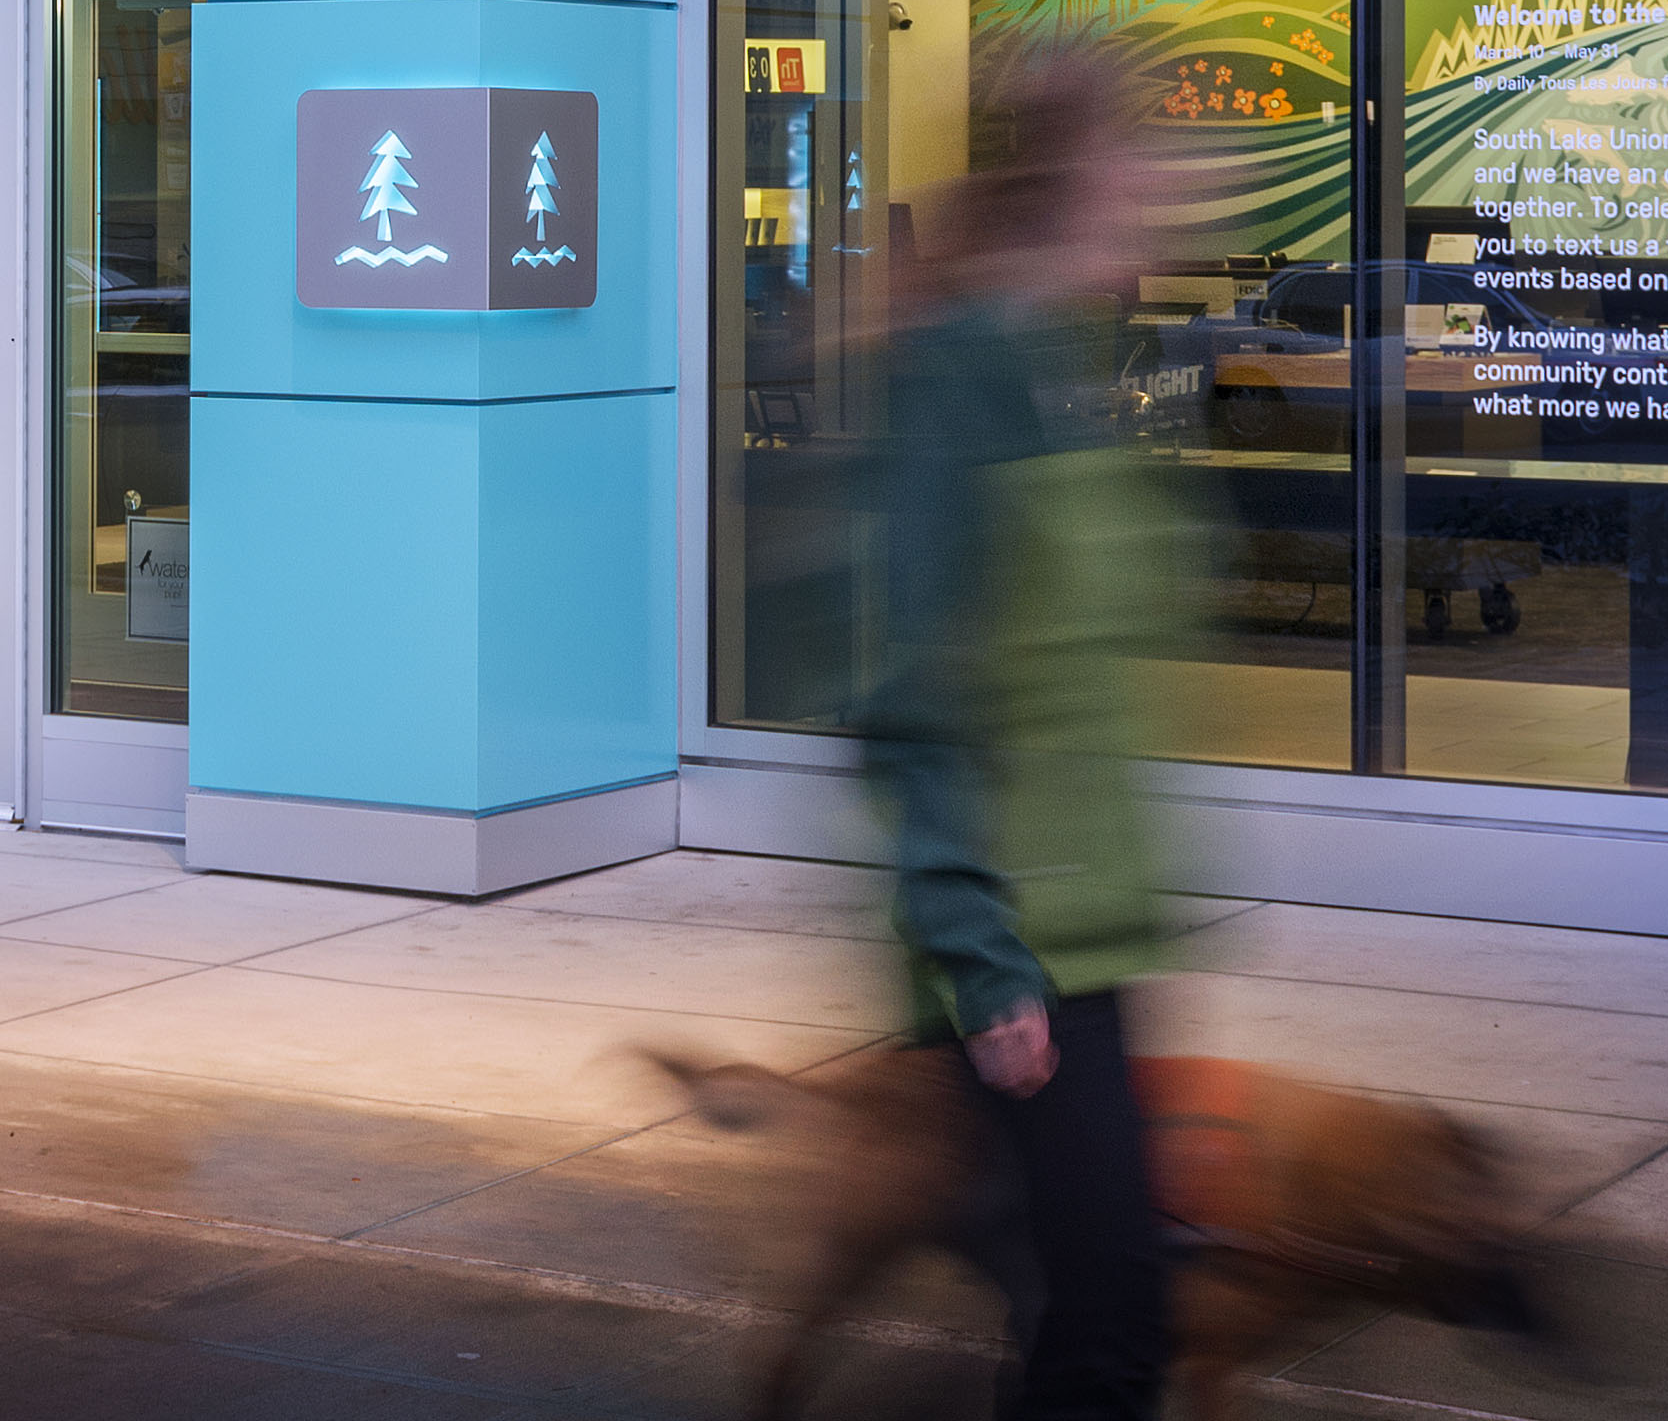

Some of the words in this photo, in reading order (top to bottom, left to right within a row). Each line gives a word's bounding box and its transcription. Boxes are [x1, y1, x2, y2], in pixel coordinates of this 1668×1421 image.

[1474, 5, 1582, 26] Welcome
[1590, 3, 1616, 25] to
[1623, 2, 1665, 24] the
[1474, 128, 1542, 150] South
[1550, 128, 1602, 150] Lake
[1474, 162, 1516, 184] and
[1523, 166, 1556, 184] we
[1564, 162, 1620, 184] have
[1627, 167, 1656, 184] an
[1474, 196, 1583, 221] together.
[1591, 196, 1618, 218] To
[1474, 236, 1515, 259] you
[1523, 234, 1546, 255] to
[1554, 234, 1603, 255] text
[1610, 238, 1637, 256] us
[1645, 238, 1659, 256] a
[1238, 284, 1265, 295] FDIC
[1473, 268, 1554, 289] events
[1561, 268, 1632, 291] based
[1639, 272, 1668, 291] on
[1473, 325, 1501, 353] By
[1508, 326, 1605, 355] knowing
[1473, 361, 1606, 389] community
[1473, 393, 1532, 416] what
[1539, 399, 1599, 417] more
[1606, 400, 1640, 418] we
[148, 559, 189, 578] wate
